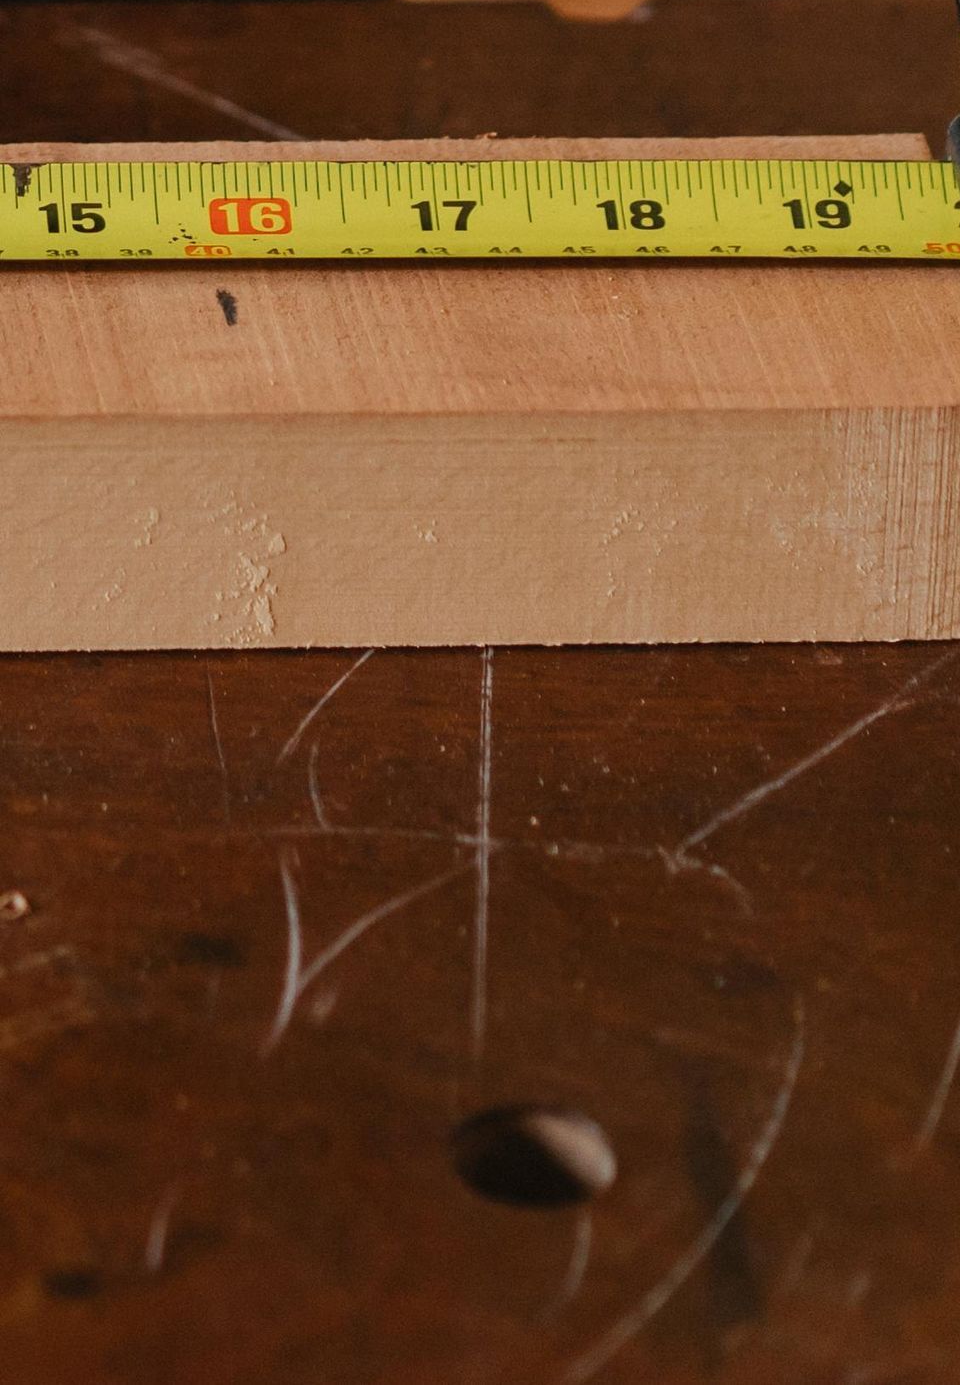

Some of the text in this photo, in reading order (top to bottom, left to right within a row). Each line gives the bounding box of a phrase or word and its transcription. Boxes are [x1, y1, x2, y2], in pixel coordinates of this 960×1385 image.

[39, 199, 852, 234] 15 16 17 18 19
[190, 246, 229, 256] 40
